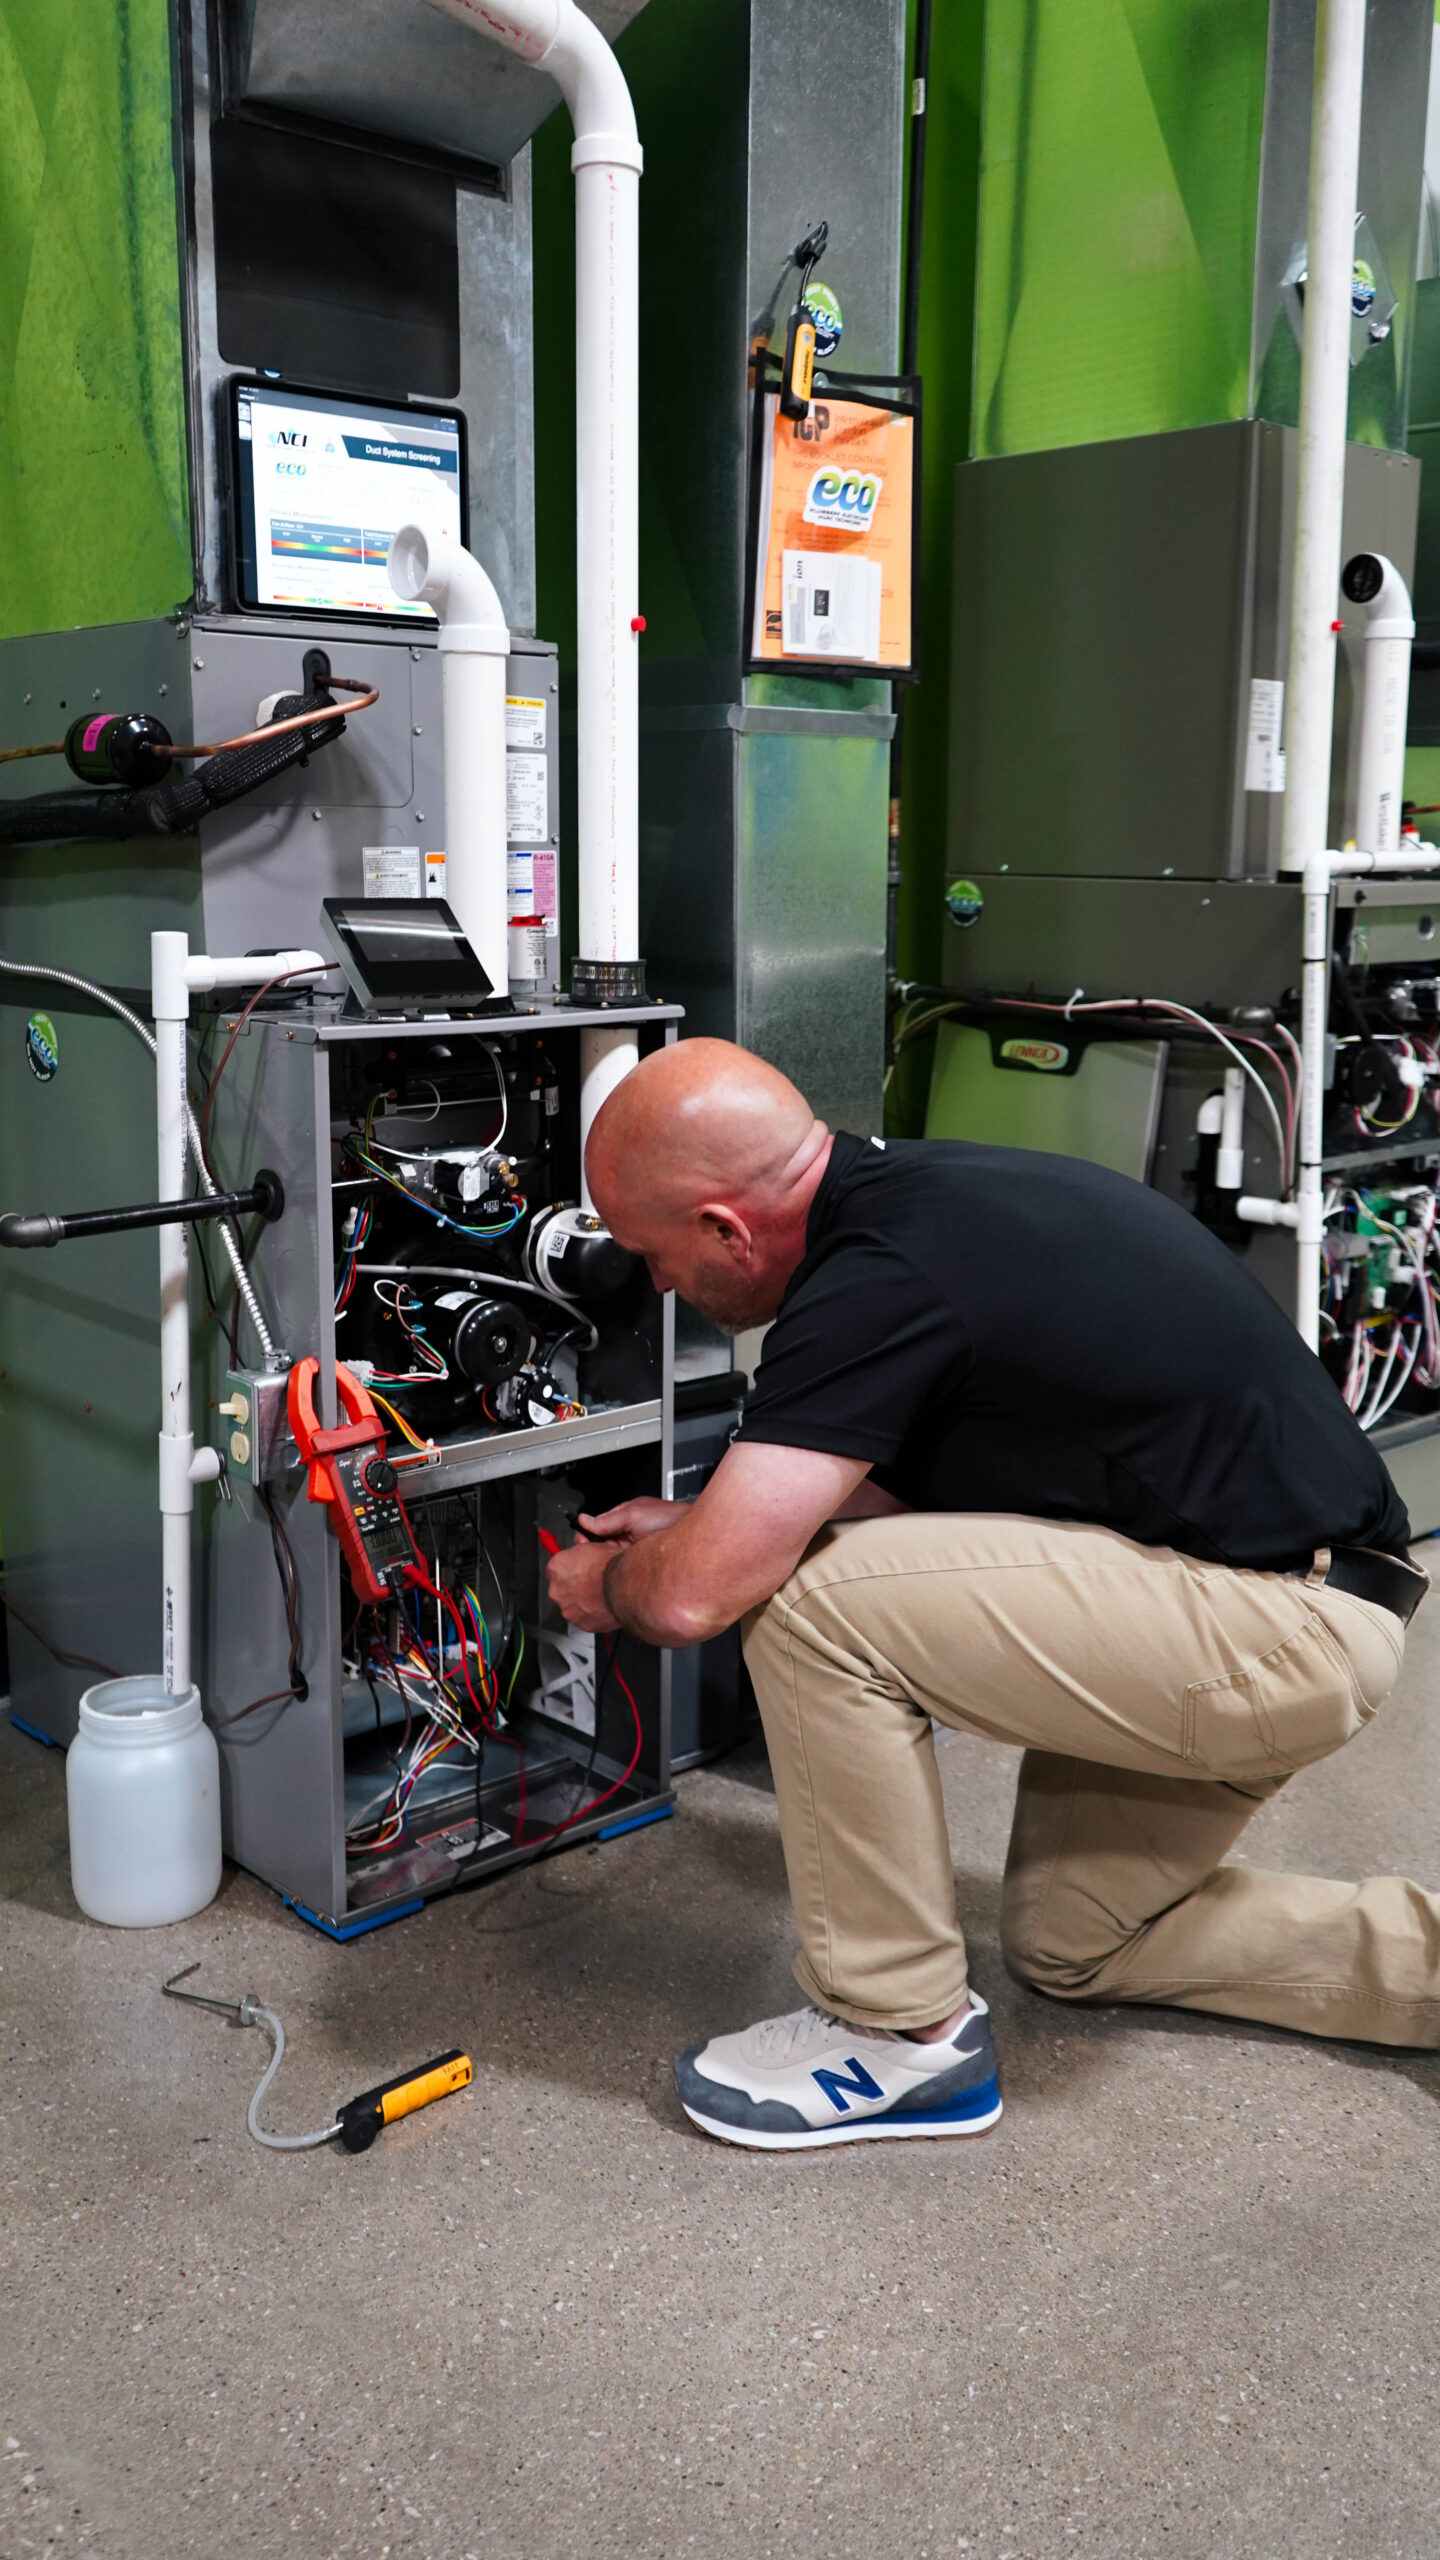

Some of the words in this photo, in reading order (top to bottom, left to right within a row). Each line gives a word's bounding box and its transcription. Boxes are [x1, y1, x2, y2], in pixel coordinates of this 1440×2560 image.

[277, 431, 307, 447] NCI
[276, 461, 307, 477] eco
[365, 444, 381, 455] Duct
[383, 447, 407, 458] System
[408, 450, 441, 465] Screening
[812, 472, 875, 514] eco
[31, 1026, 56, 1063] eco
[811, 2056, 888, 2117] N
